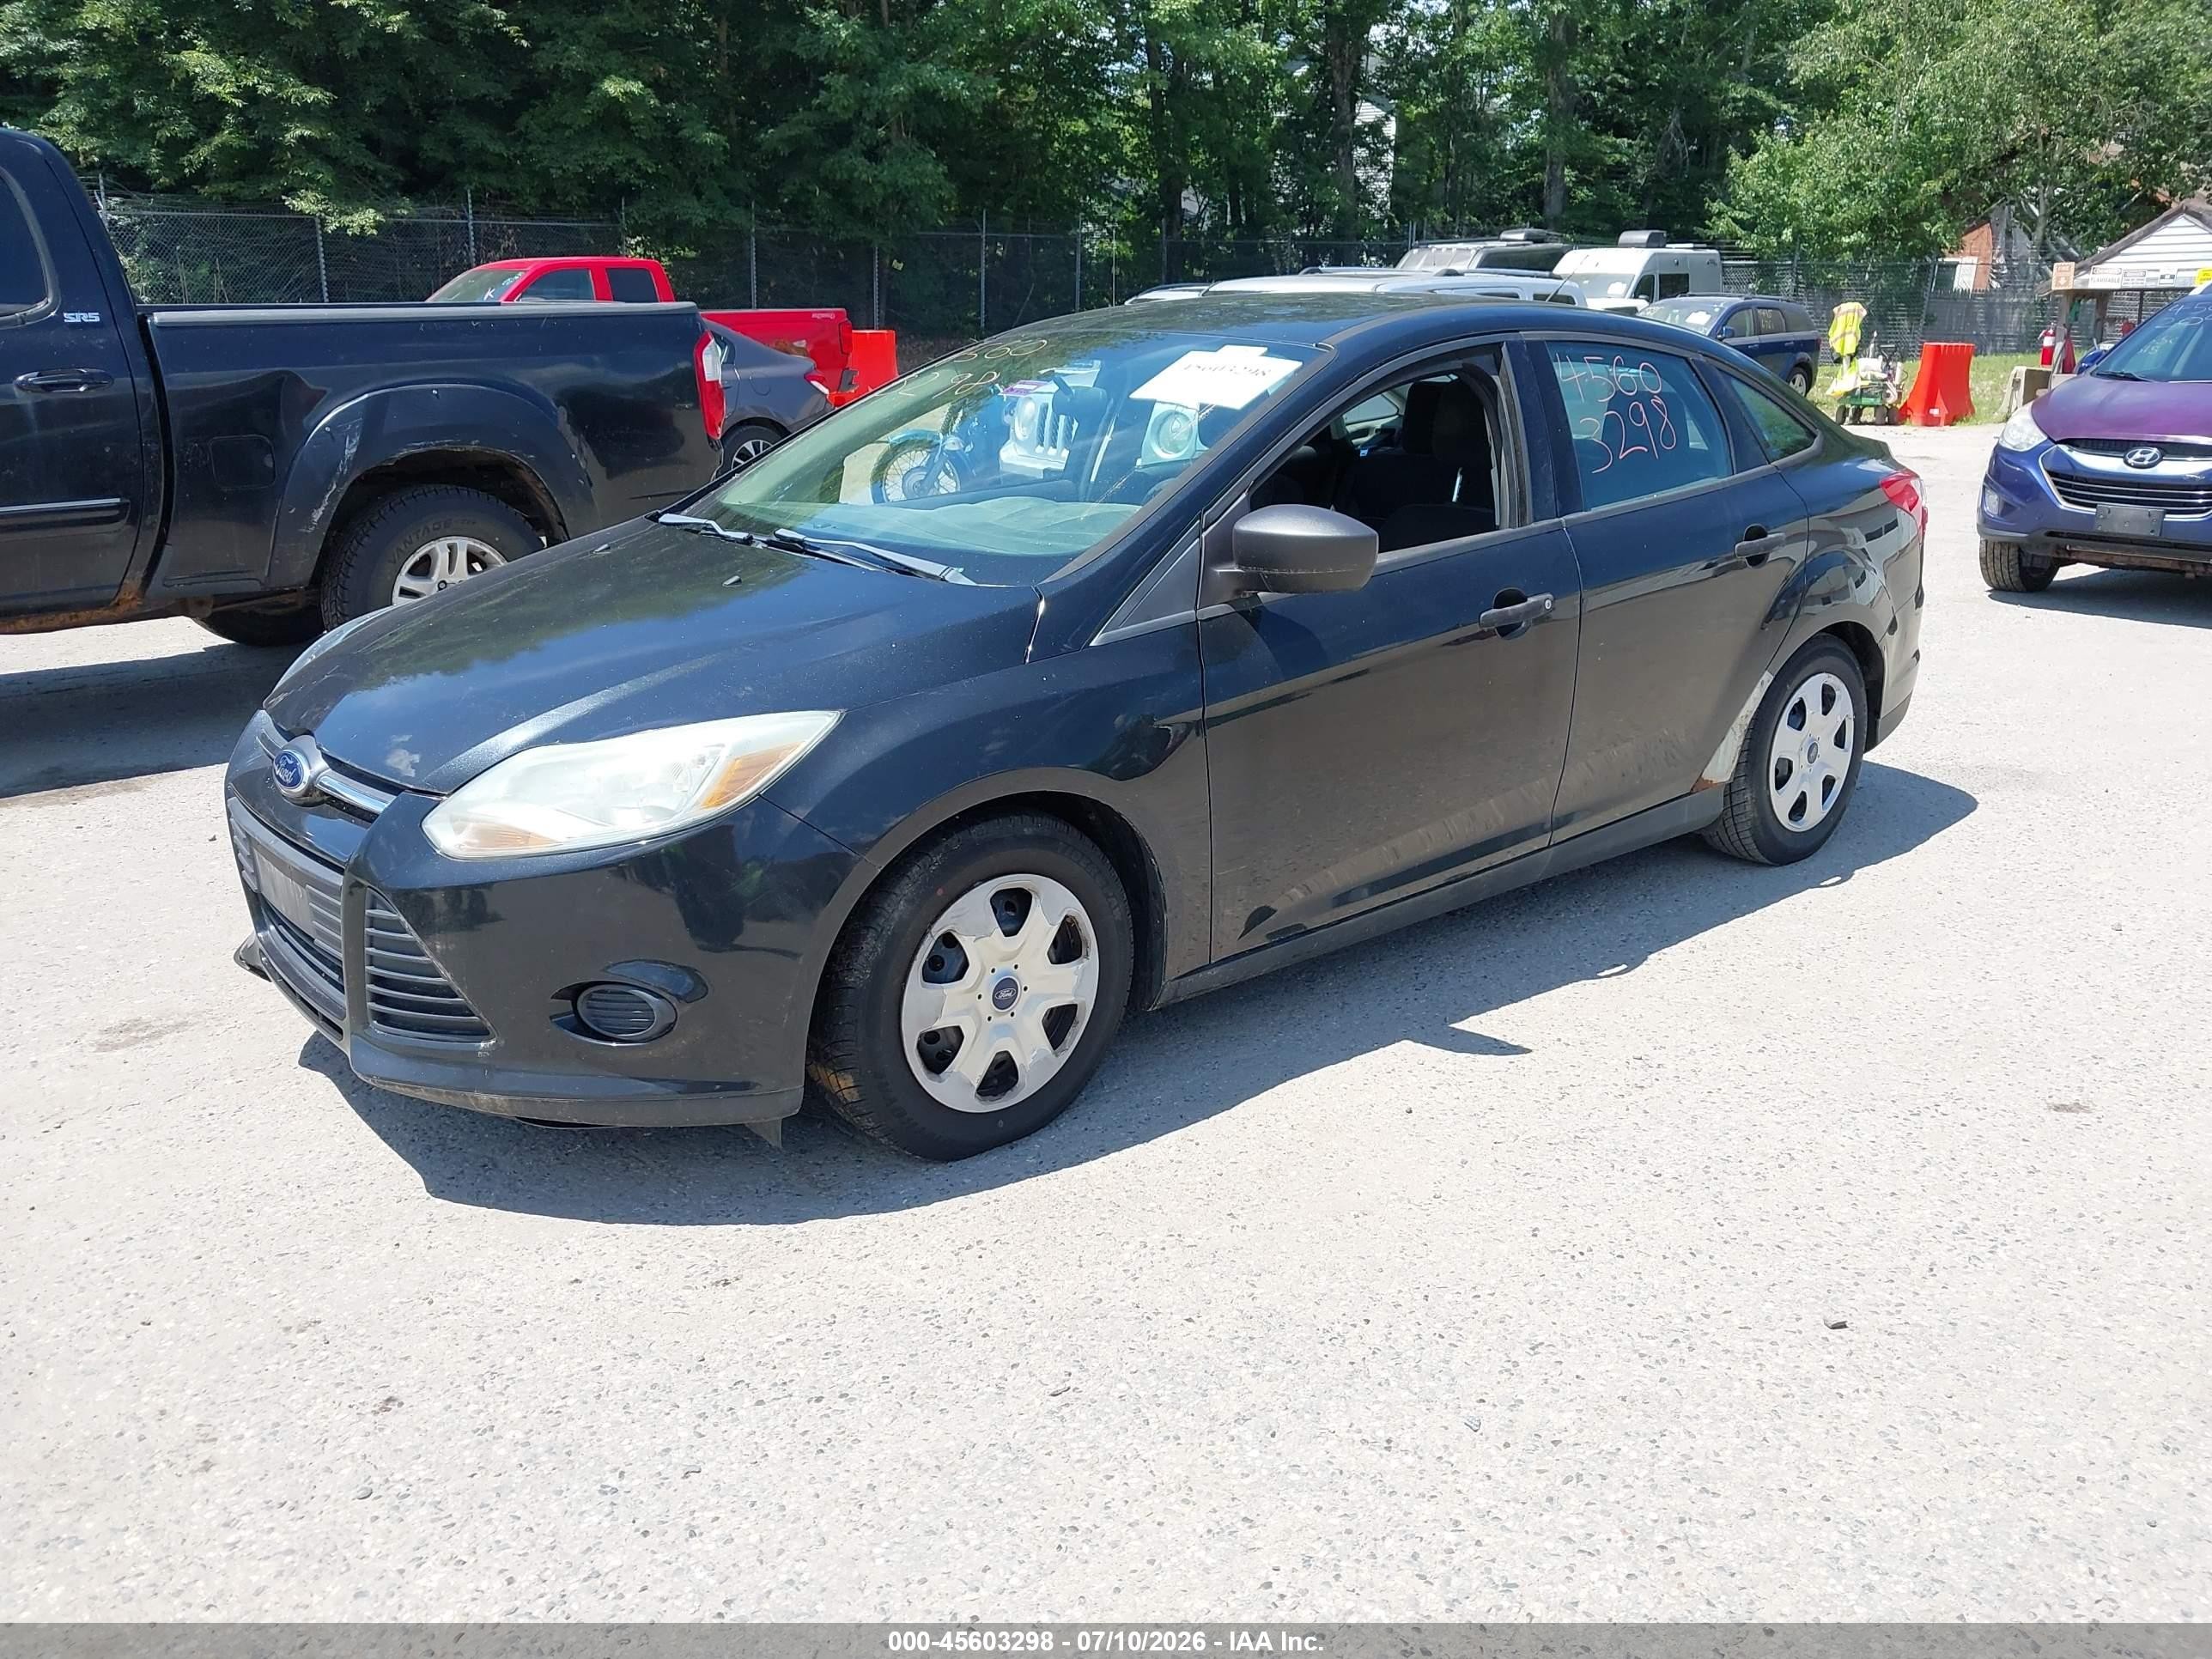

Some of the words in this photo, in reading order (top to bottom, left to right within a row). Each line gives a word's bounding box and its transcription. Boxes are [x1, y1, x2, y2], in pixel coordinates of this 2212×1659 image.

[1555, 352, 1662, 403] 4560
[1579, 395, 1677, 474] 3298
[275, 755, 297, 784] Ford
